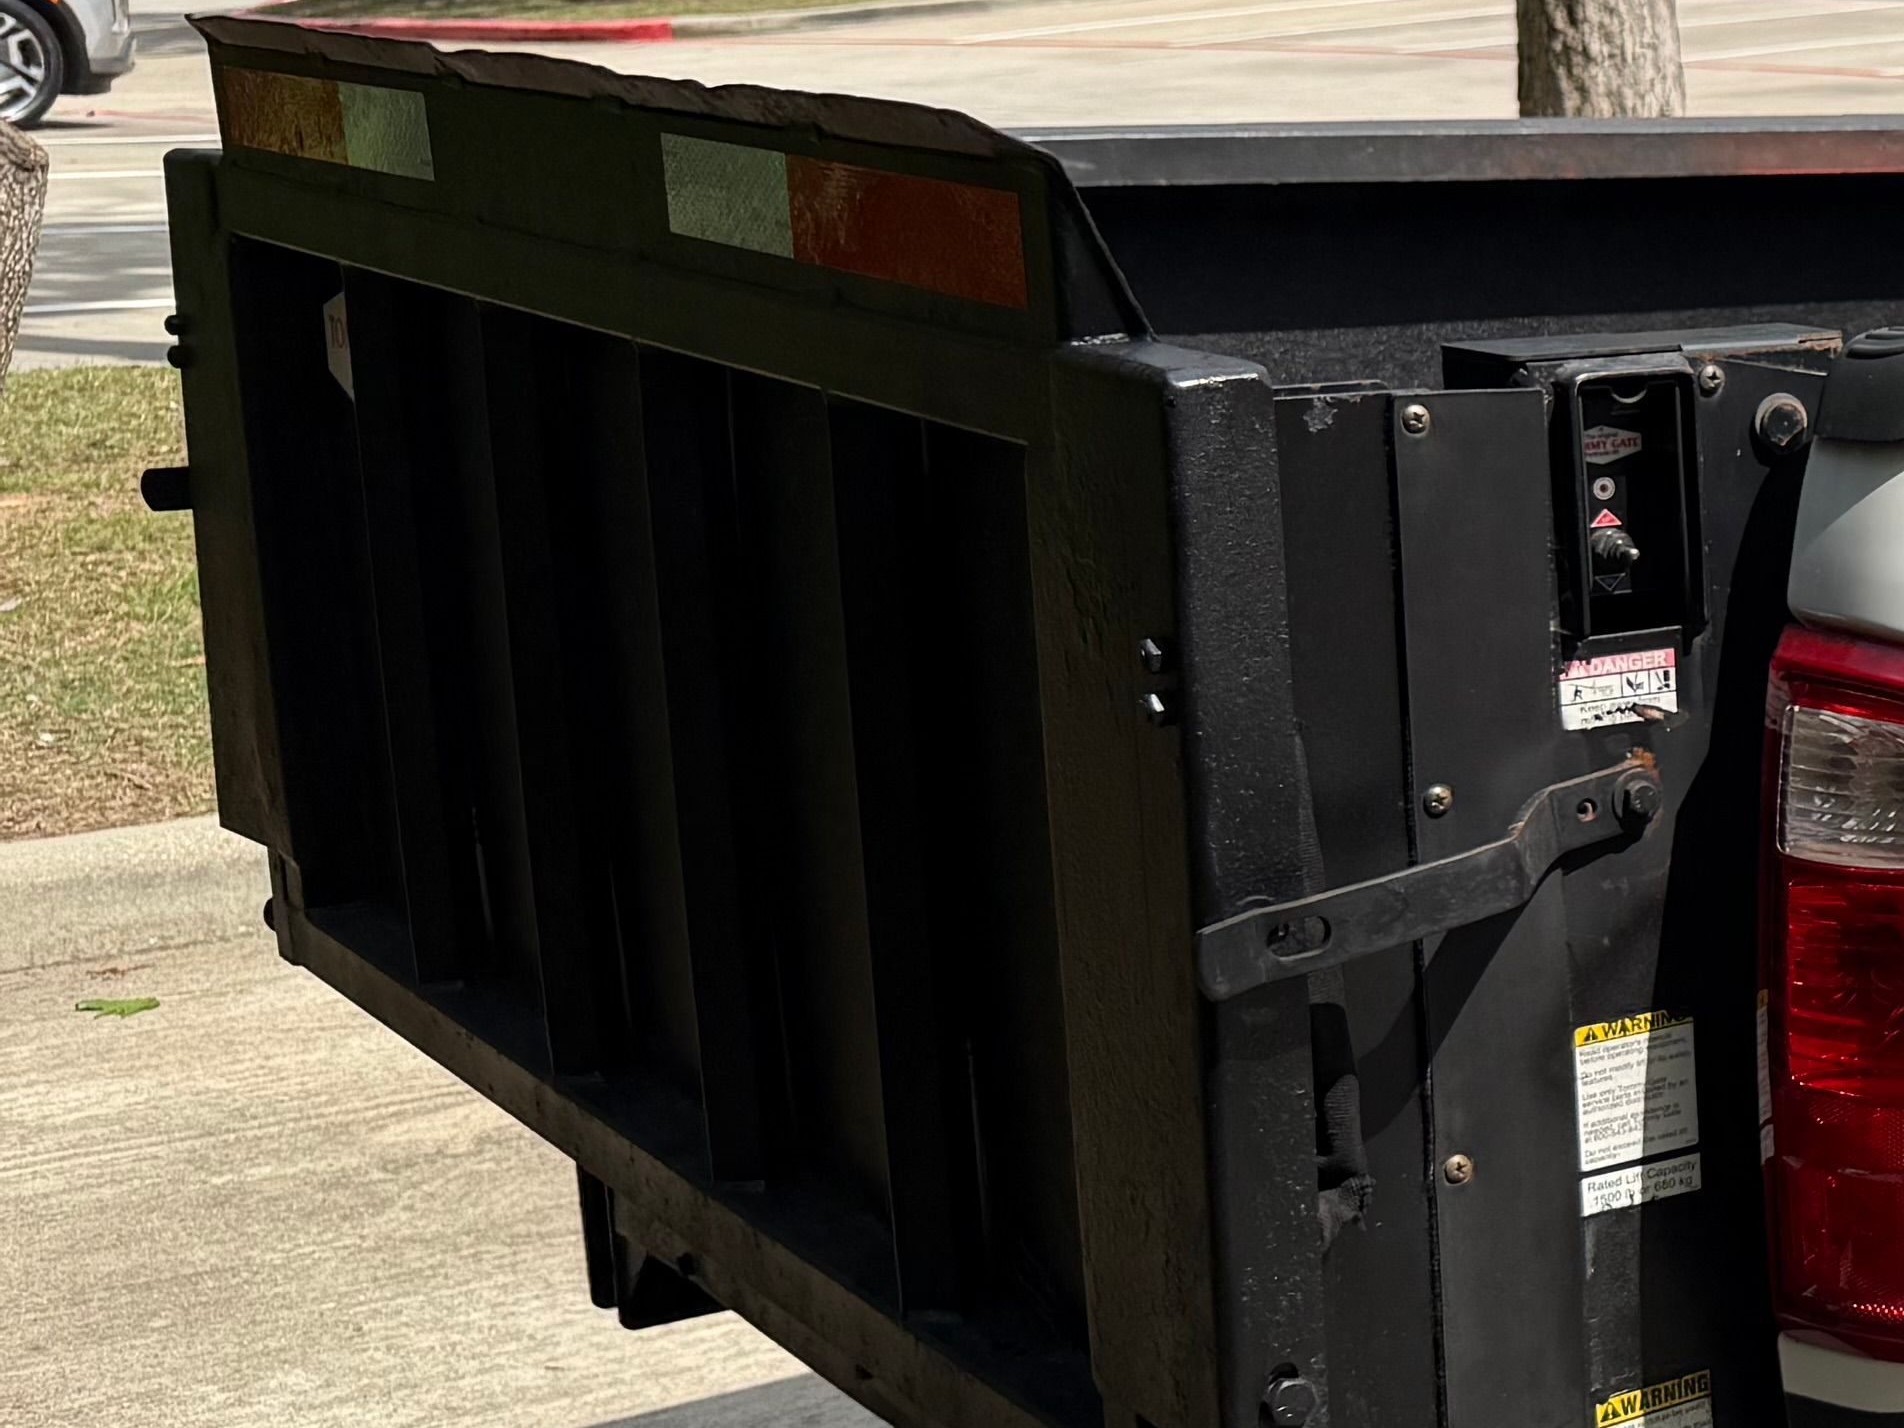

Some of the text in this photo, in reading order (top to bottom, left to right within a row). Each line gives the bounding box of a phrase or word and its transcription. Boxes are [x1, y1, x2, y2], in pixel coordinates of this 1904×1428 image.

[1590, 650, 1667, 673] DANGER
[1587, 1178, 1623, 1193] Rated
[1646, 1160, 1697, 1179] Capacity
[1593, 1190, 1622, 1206] 1500
[1620, 1372, 1710, 1416] WARNING
